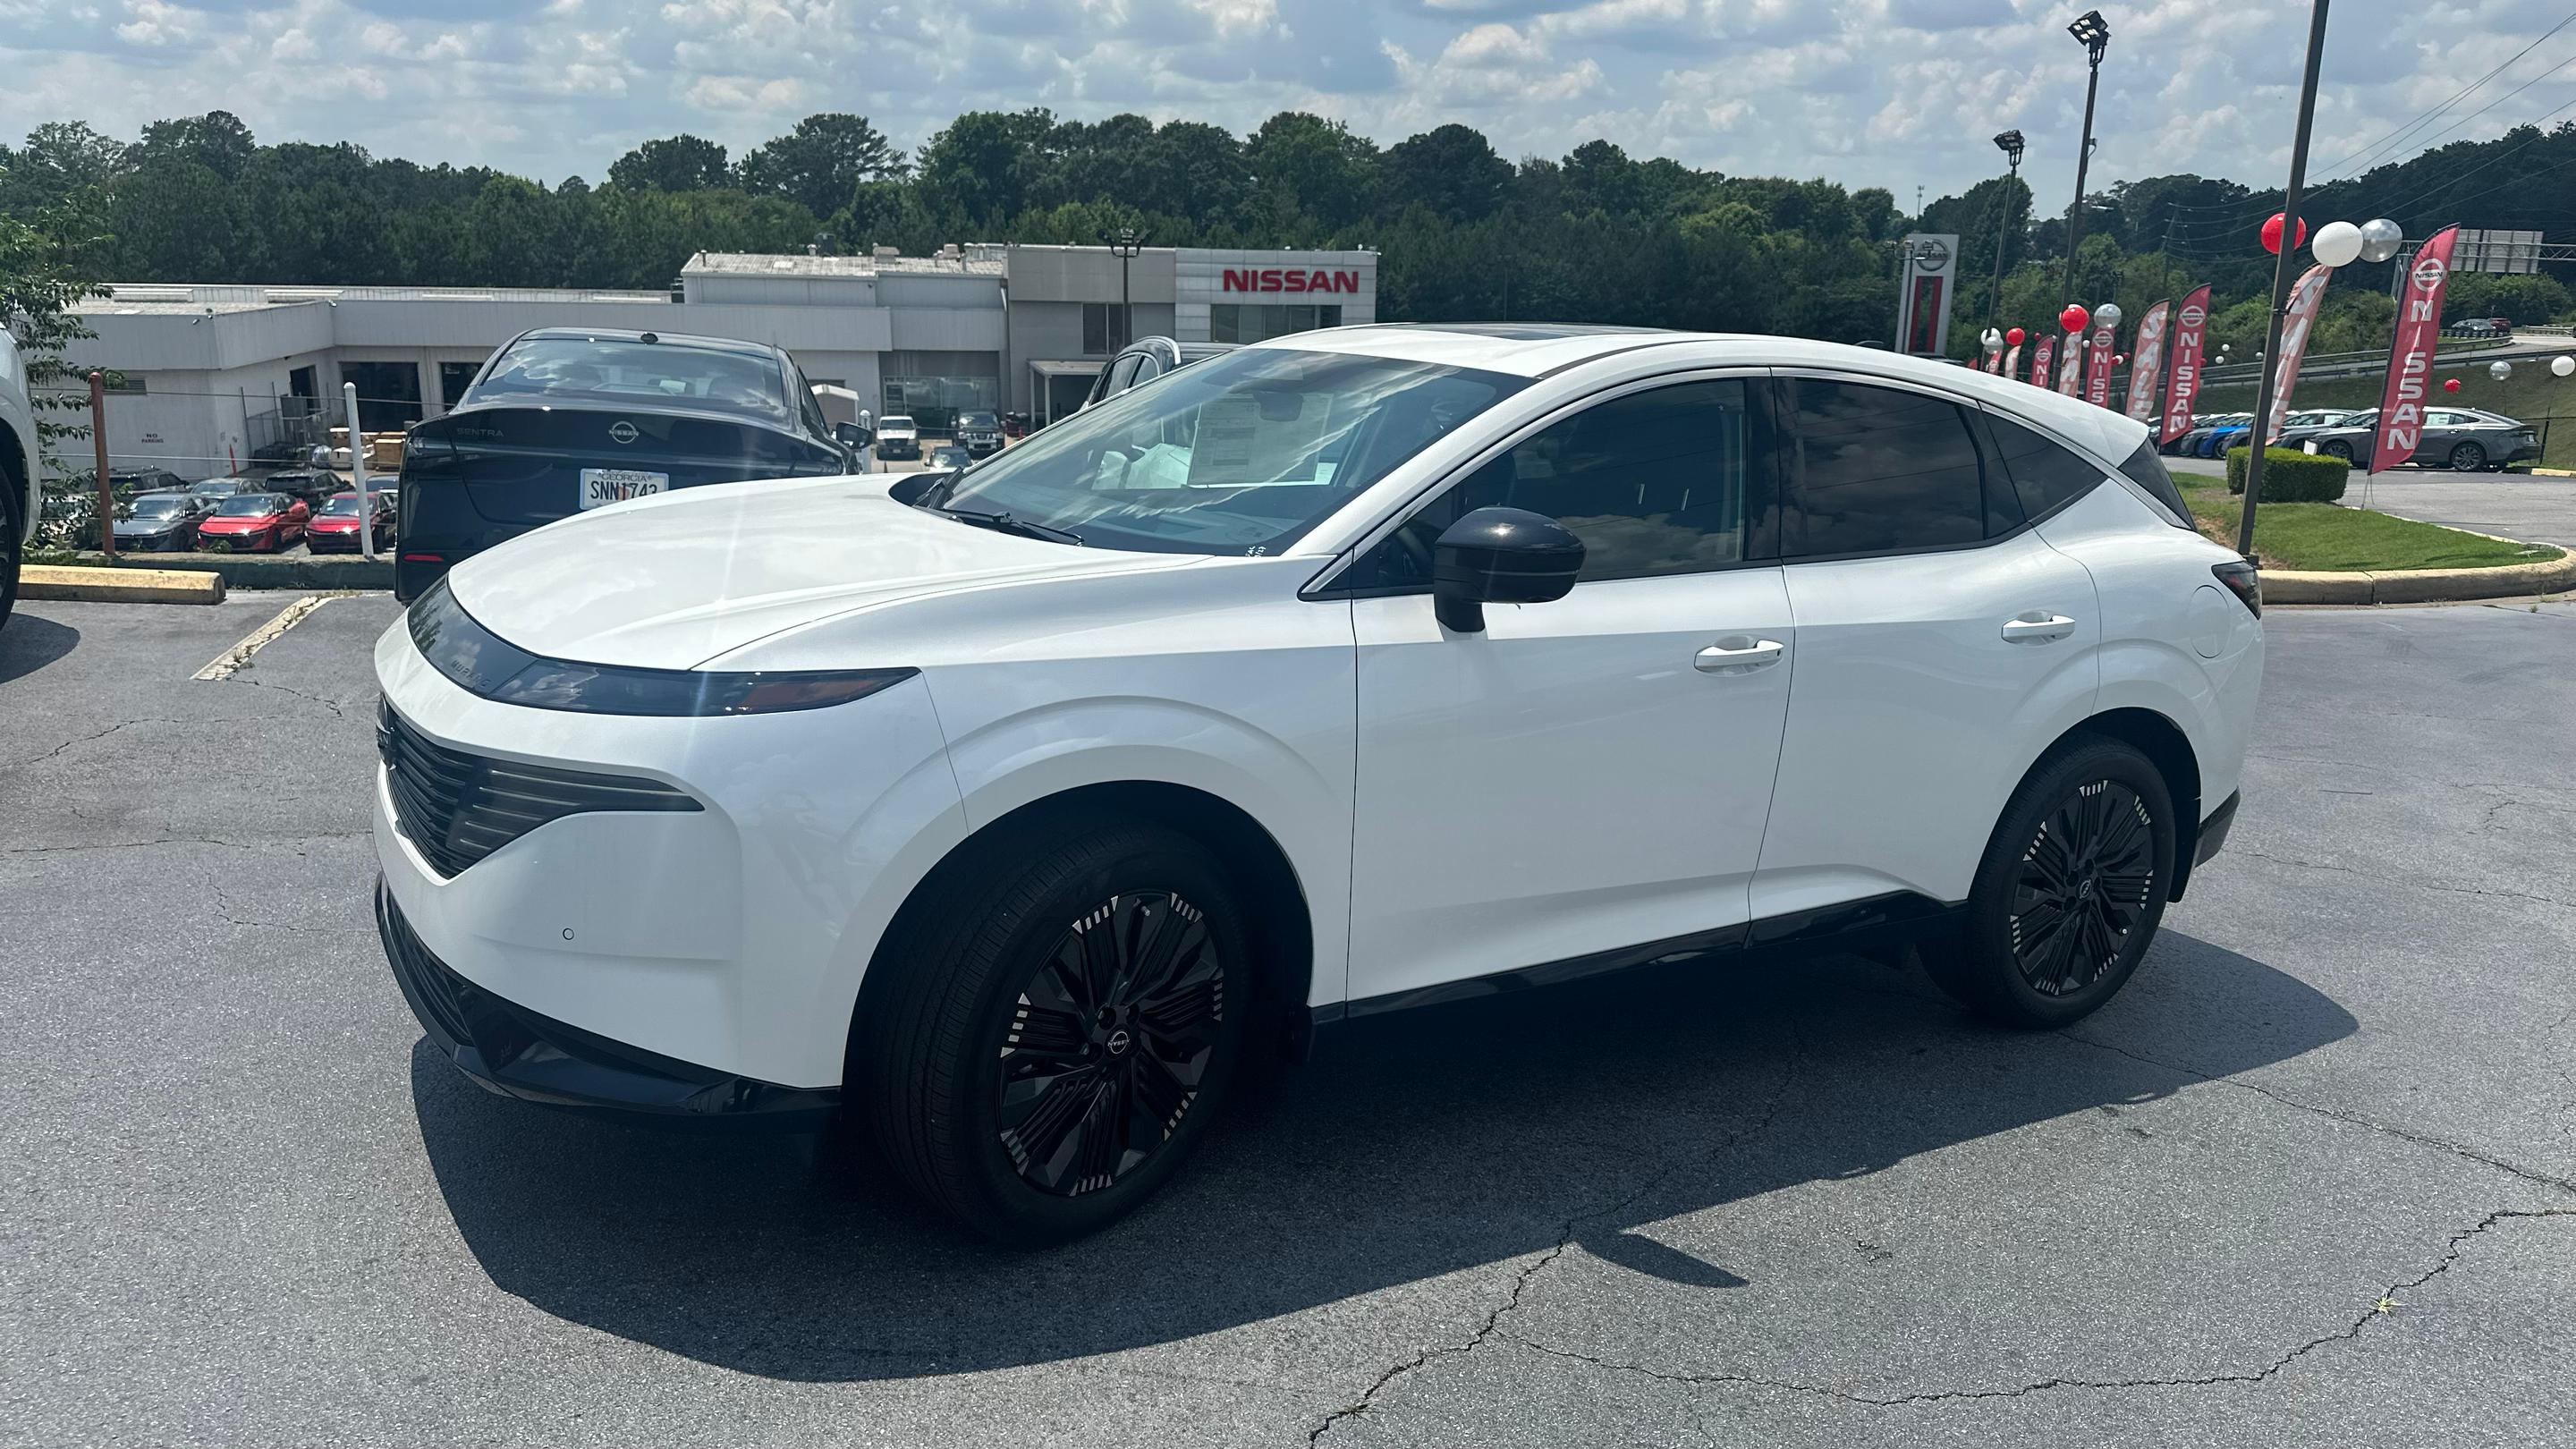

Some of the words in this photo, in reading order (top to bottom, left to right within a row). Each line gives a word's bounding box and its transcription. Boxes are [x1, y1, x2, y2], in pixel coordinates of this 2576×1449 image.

[1223, 269, 1360, 293] NISSAN
[2091, 352, 2108, 403] NISS
[2130, 310, 2167, 422] SALE
[2169, 332, 2199, 432] NISSAN
[2386, 300, 2434, 450] NISSAN
[457, 428, 504, 437] SENTRA
[590, 480, 657, 501] SNN1743
[601, 473, 648, 482] GEORGIA
